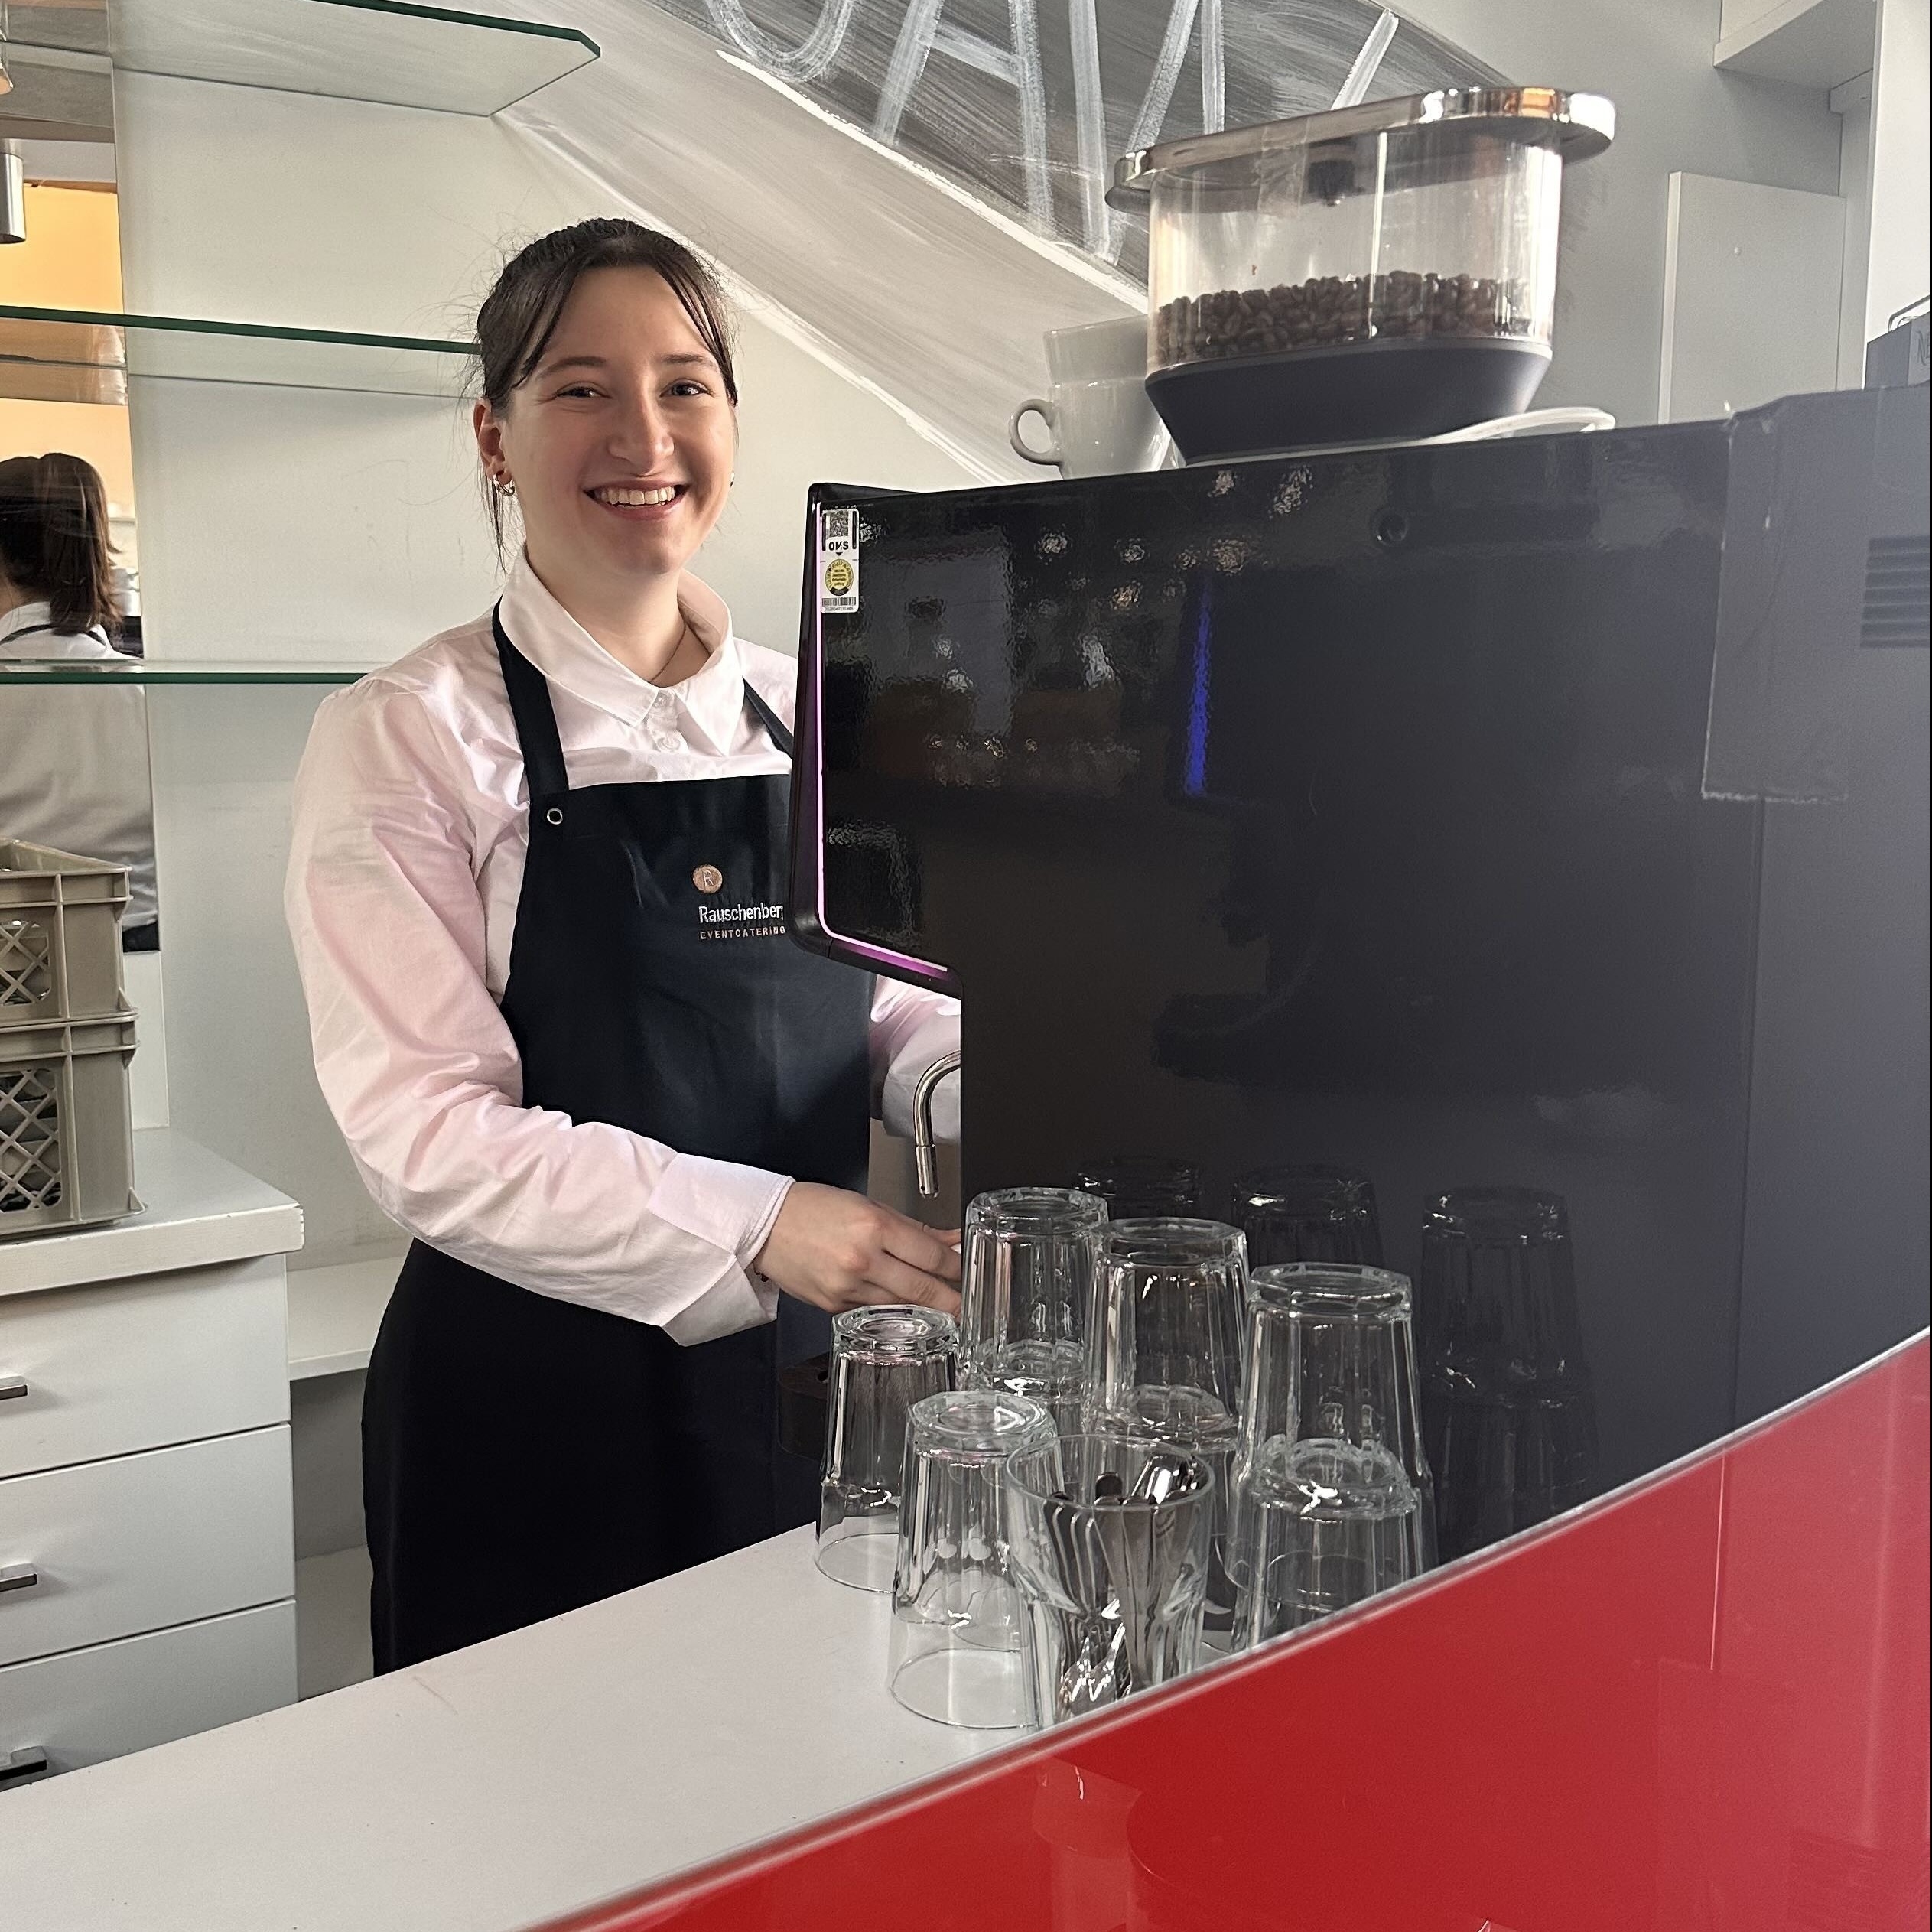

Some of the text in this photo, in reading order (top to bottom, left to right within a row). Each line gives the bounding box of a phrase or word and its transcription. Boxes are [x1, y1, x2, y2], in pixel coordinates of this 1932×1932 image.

[703, 870, 714, 887] R
[698, 903, 784, 923] Rauschenber
[700, 925, 786, 939] EVENTCATERING
